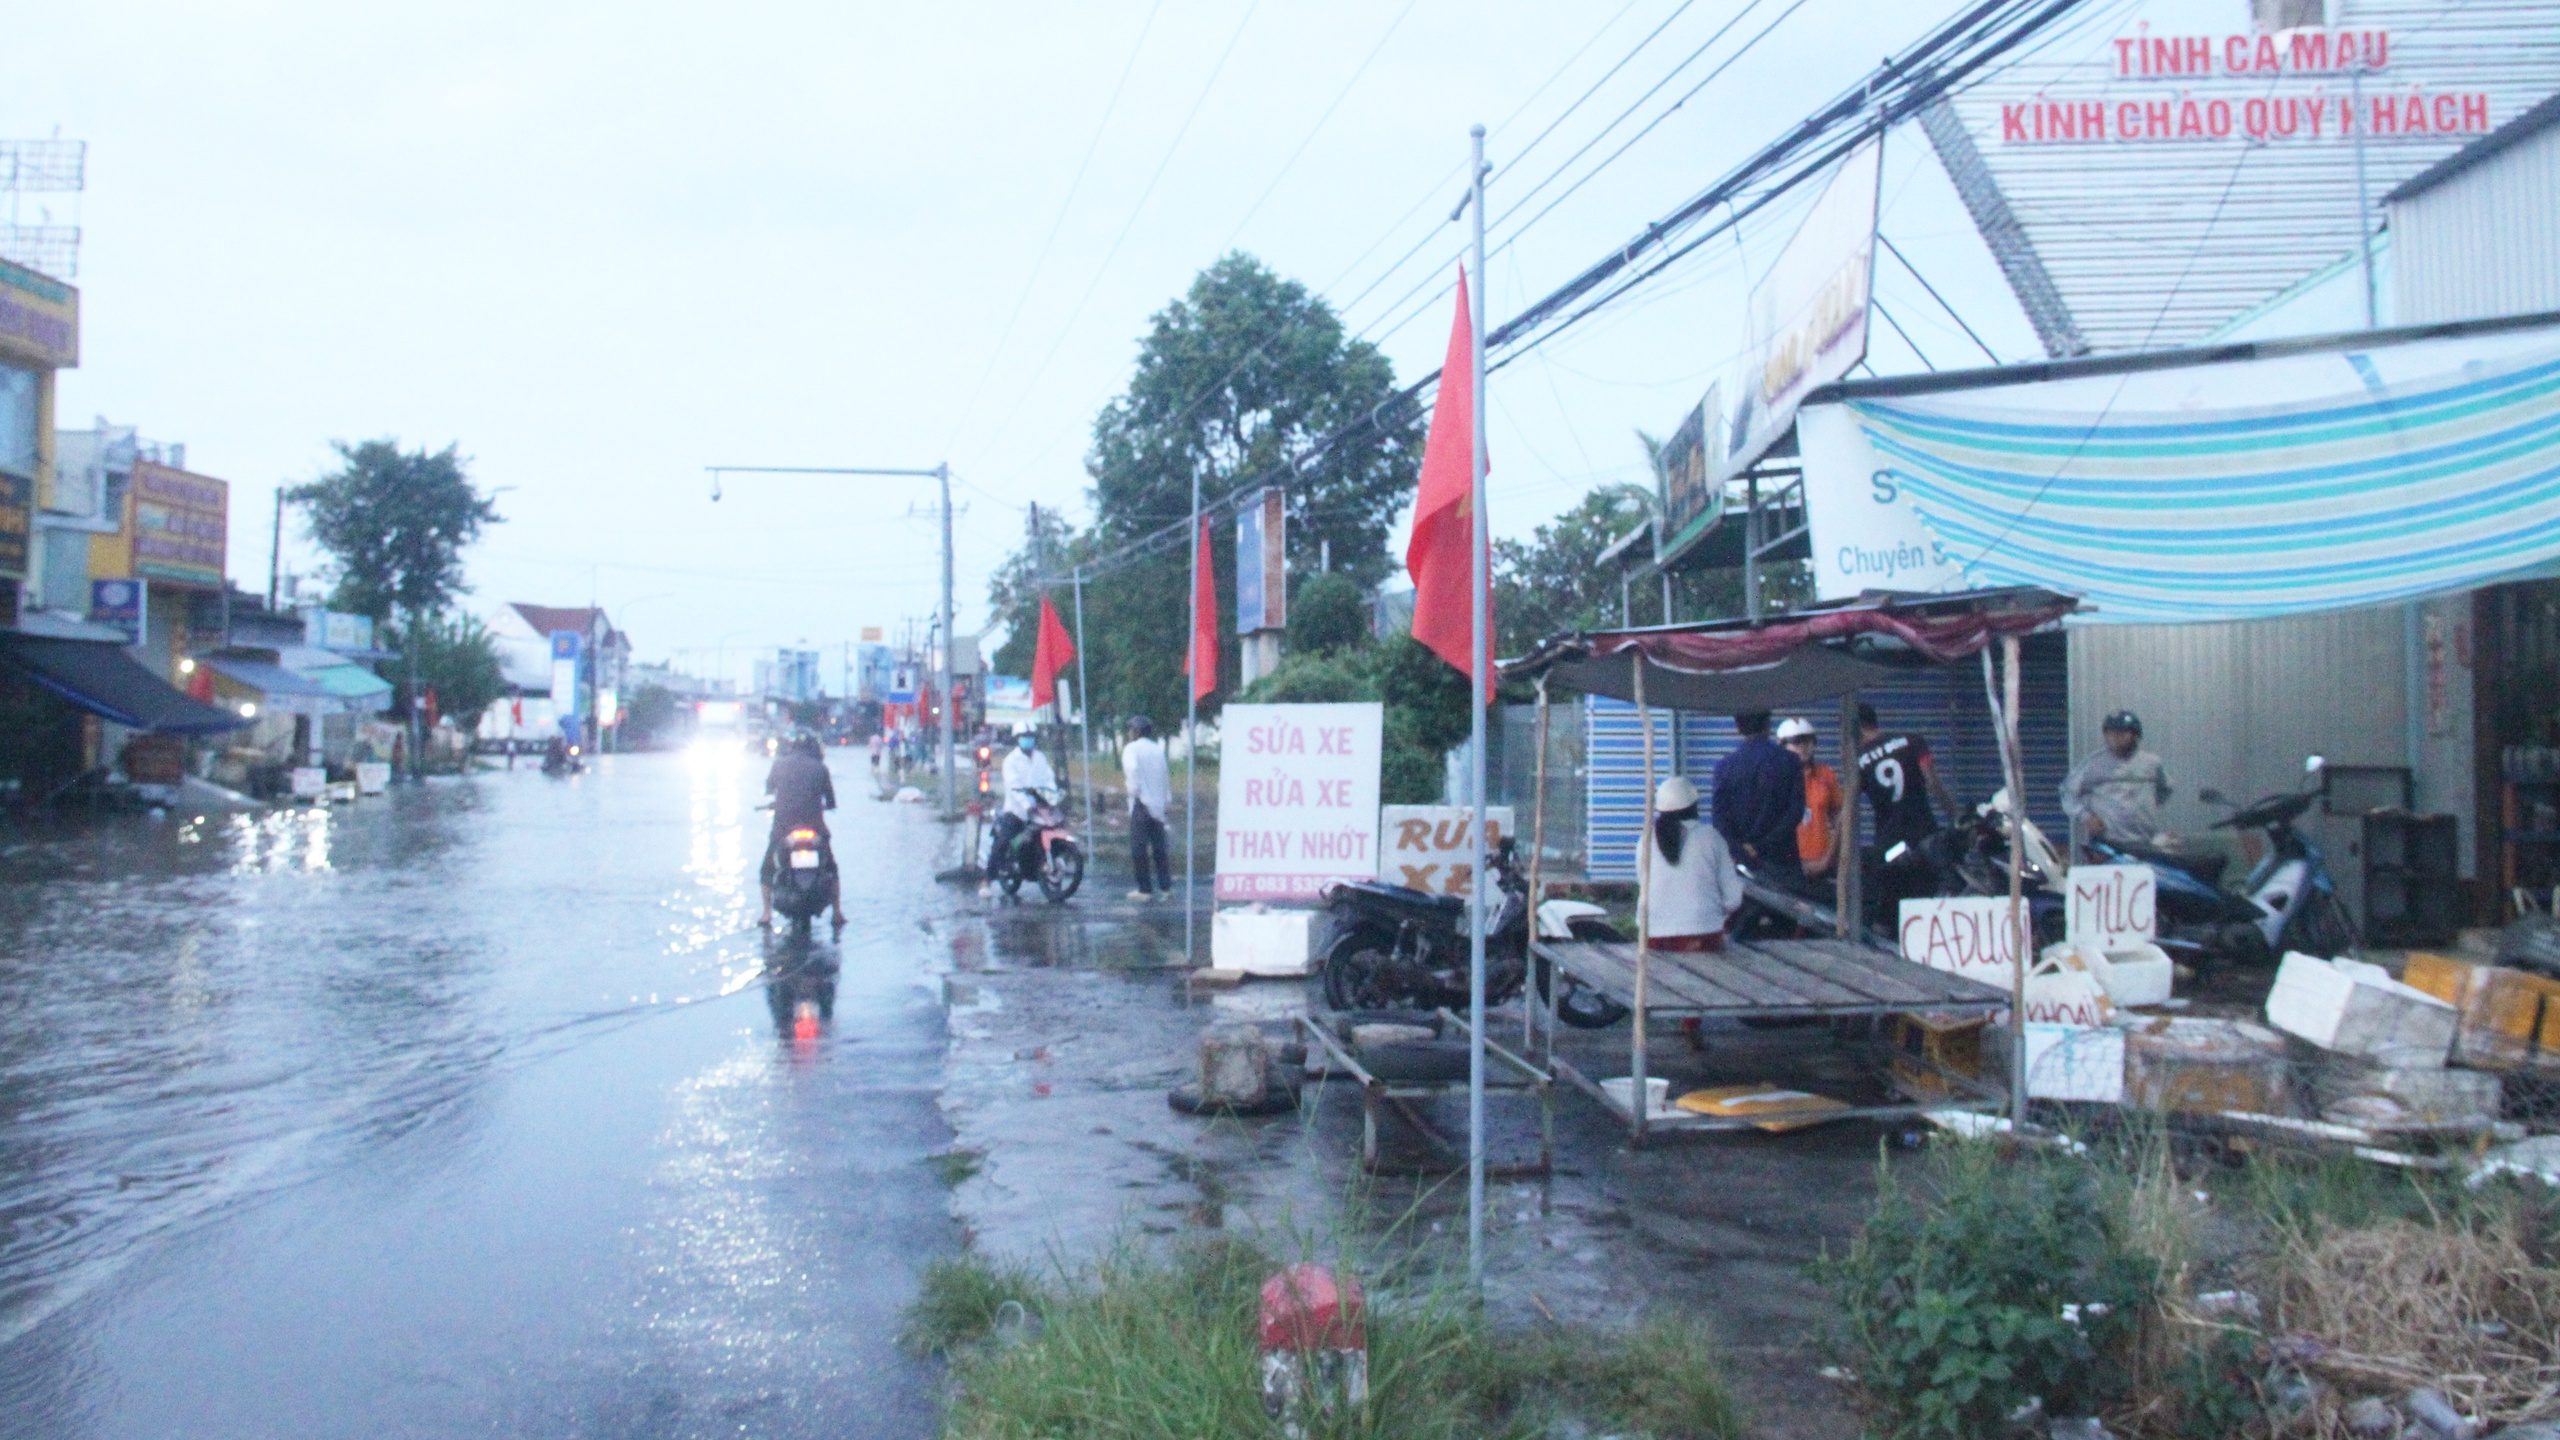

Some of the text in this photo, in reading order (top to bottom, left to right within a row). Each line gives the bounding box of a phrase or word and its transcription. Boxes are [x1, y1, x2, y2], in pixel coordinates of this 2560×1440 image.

[2113, 20, 2211, 75] TỈNH
[2291, 31, 2388, 71] MAU
[2002, 91, 2106, 141] KÍNH
[2116, 88, 2232, 139] CHÀO
[2244, 85, 2325, 140] QUÝ
[1838, 540, 1926, 579] Chuyên
[1247, 714, 1355, 756] SỬA XE
[1244, 766, 1354, 809] RỬA XE
[1874, 757, 1906, 802] 9
[1225, 822, 1371, 861] THAY NHỚT
